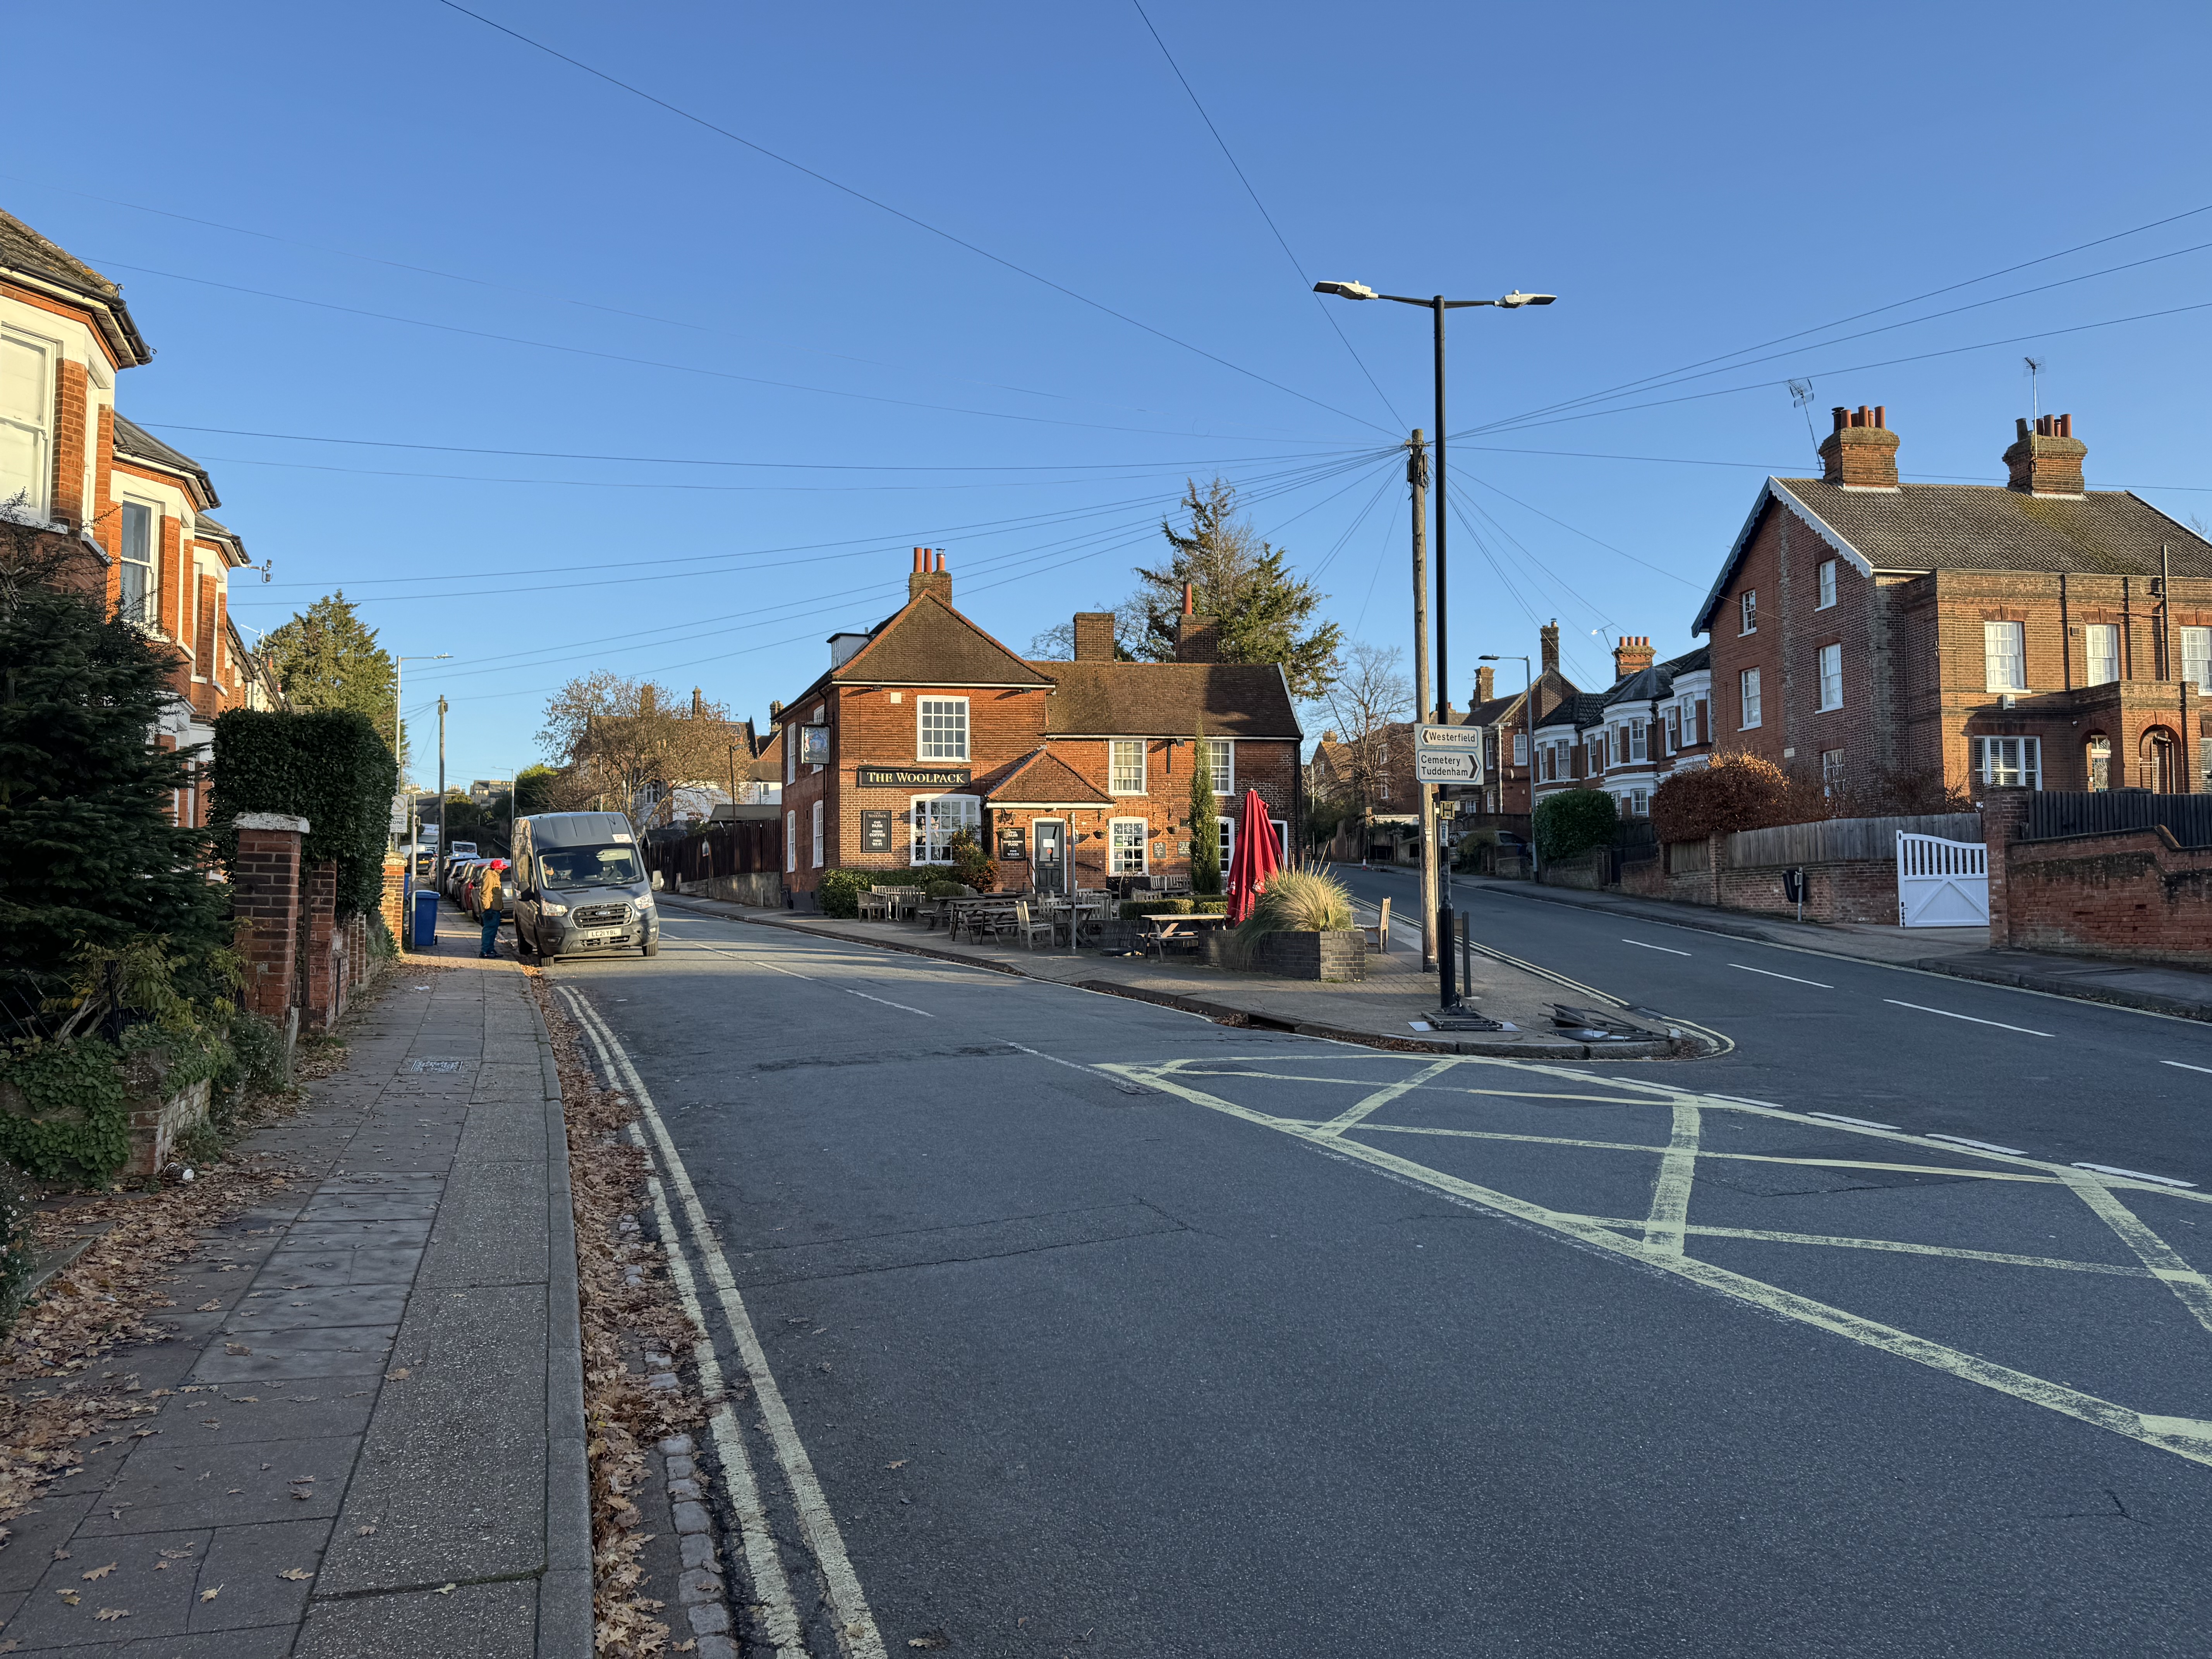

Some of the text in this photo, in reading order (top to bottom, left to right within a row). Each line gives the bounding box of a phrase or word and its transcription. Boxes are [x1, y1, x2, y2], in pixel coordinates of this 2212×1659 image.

[1429, 732, 1475, 742] Westerfield
[1421, 755, 1460, 766] Cemetery
[1421, 766, 1468, 776] Tuddenham
[867, 772, 965, 783] THE WOOLPACK
[1443, 803, 1453, 817] H
